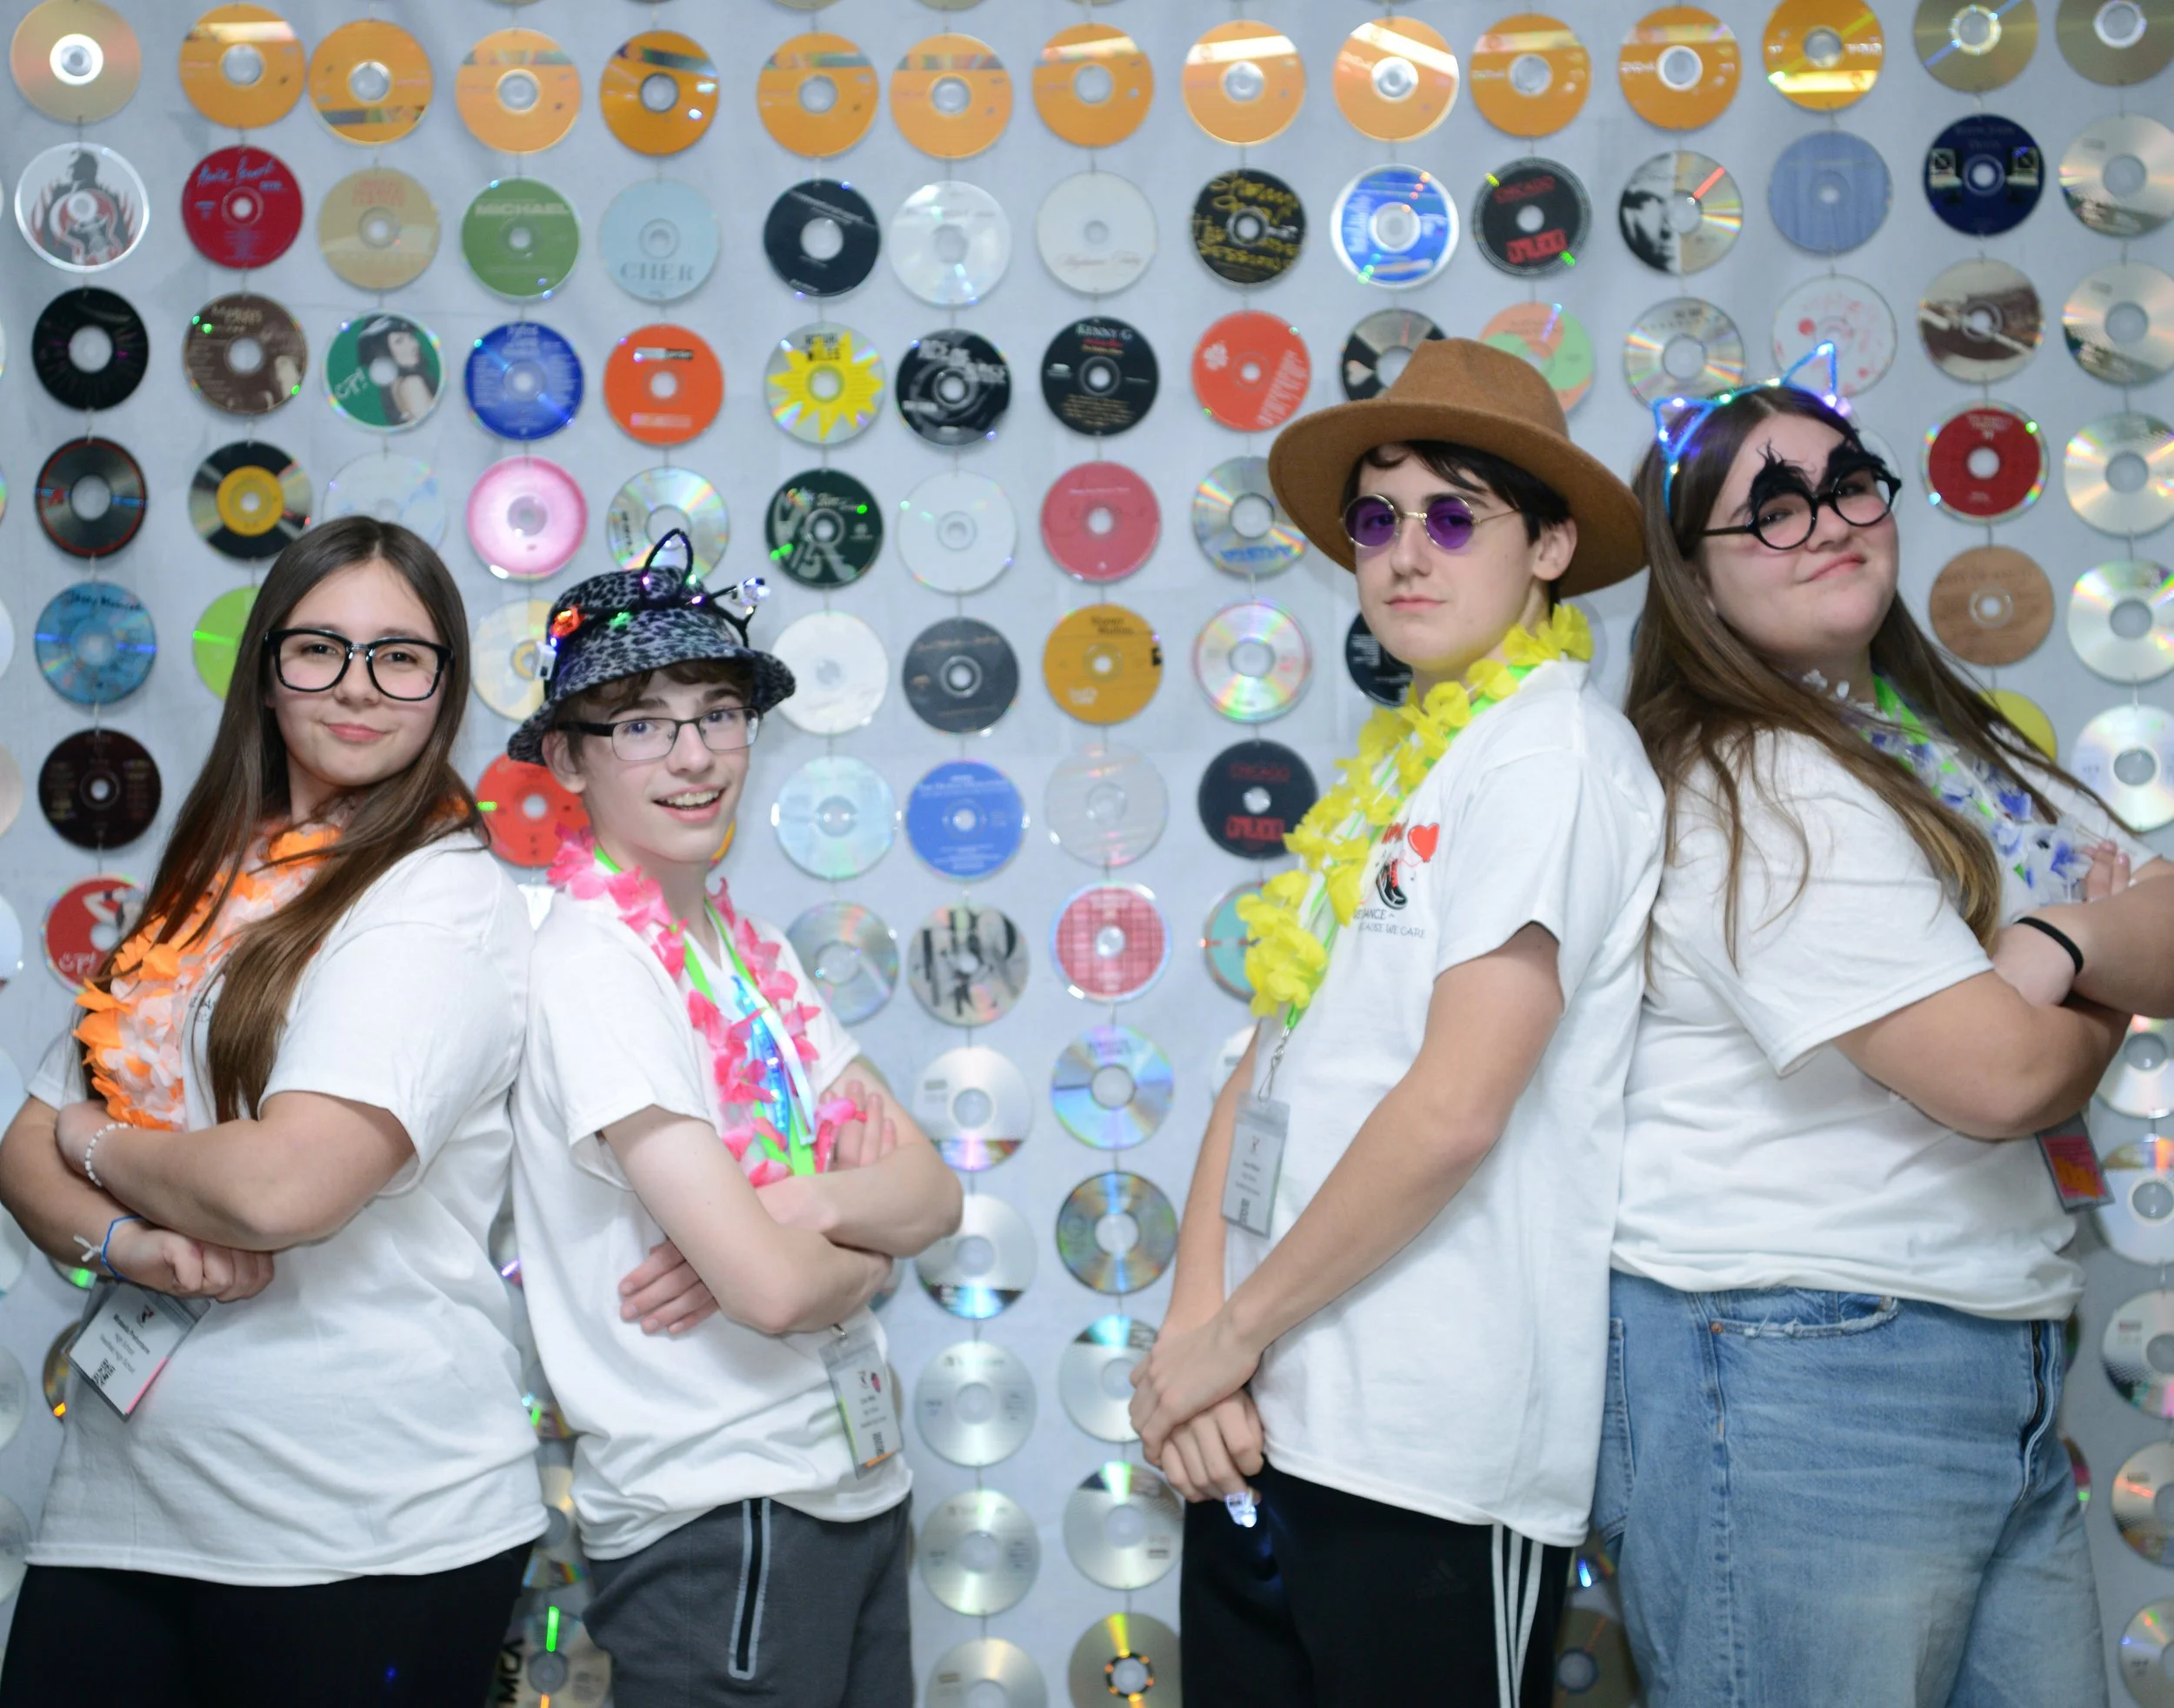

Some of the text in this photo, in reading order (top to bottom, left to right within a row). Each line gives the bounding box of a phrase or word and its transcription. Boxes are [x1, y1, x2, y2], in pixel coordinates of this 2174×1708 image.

[619, 262, 695, 282] CHER
[1075, 323, 1134, 340] KENNY G
[1400, 925, 1426, 938] CARE
